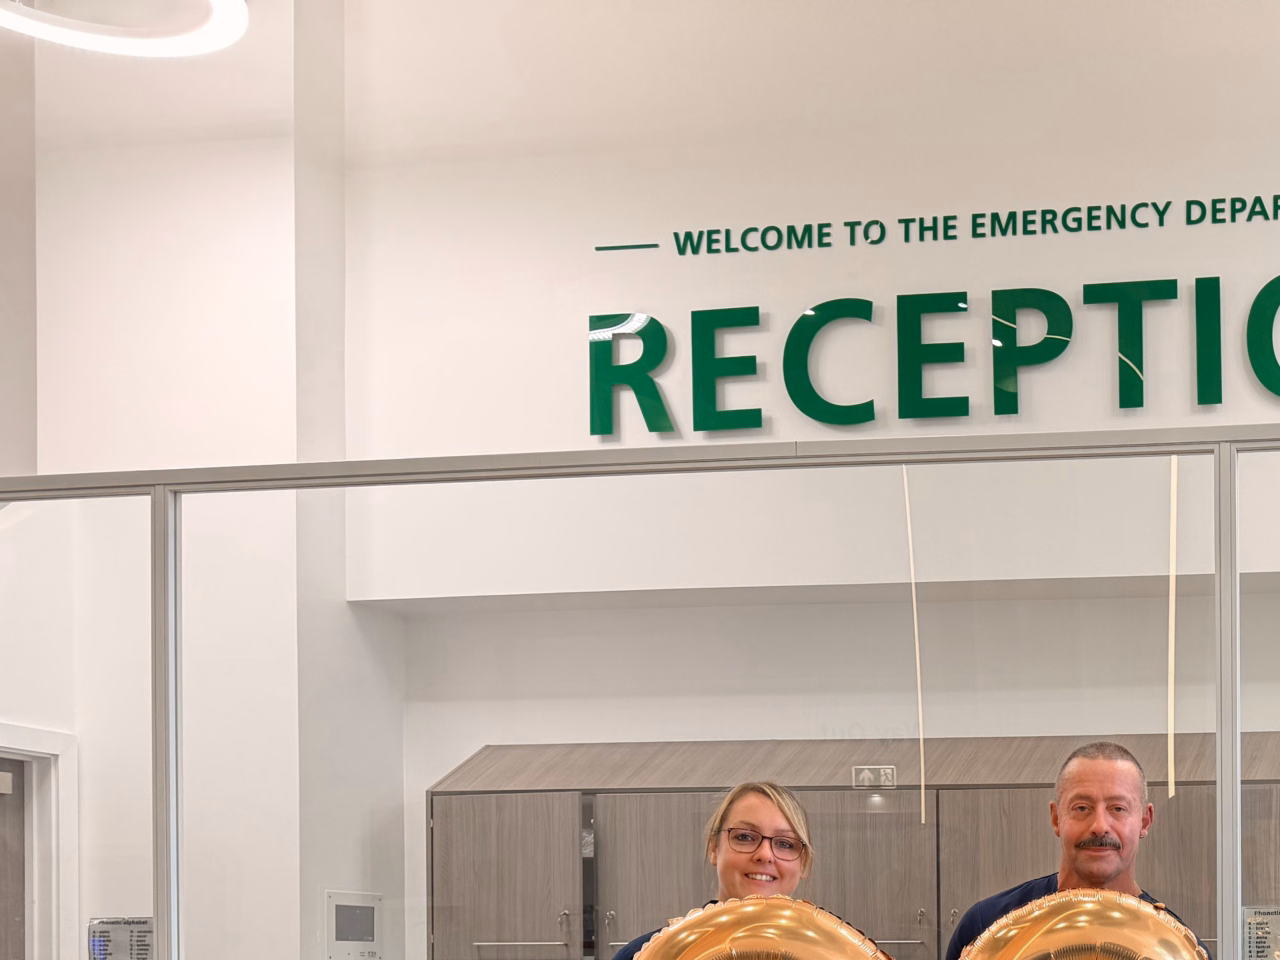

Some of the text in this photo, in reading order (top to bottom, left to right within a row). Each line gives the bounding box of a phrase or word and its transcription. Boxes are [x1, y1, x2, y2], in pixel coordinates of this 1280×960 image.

[673, 222, 832, 256] WELCOME
[843, 219, 887, 247] TO
[897, 214, 958, 243] THE
[970, 201, 1172, 238] EMERGENCY
